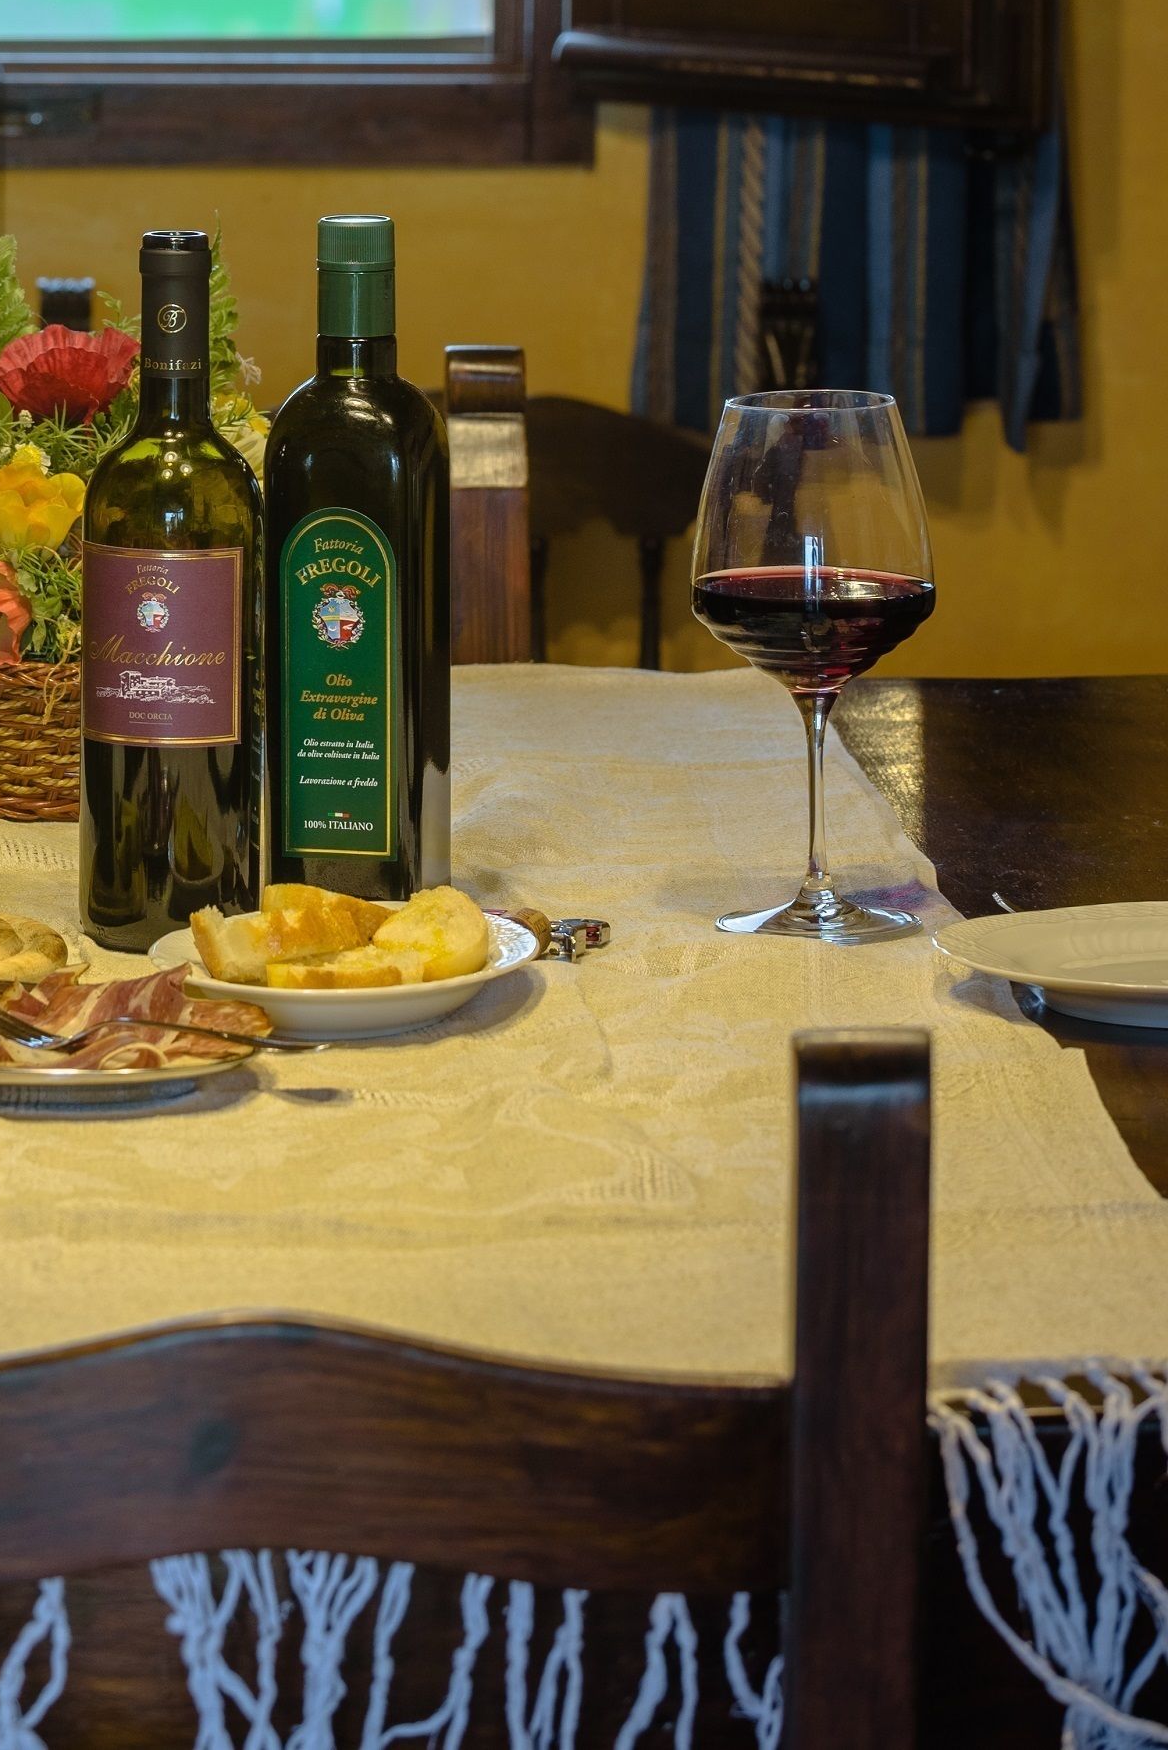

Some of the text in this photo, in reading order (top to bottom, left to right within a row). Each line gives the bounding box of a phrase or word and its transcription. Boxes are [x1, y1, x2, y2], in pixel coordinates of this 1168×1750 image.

[144, 358, 202, 371] Bonifazi
[314, 538, 364, 554] Fattoria
[294, 557, 382, 588] FREGOLI
[125, 575, 180, 595] FREGOLI
[90, 634, 225, 666] Macchione
[326, 674, 352, 687] Olio
[299, 691, 378, 707] Extravergine
[129, 711, 173, 720] DOC ORCIA
[314, 708, 365, 721] di Oliva
[304, 738, 319, 747] Olio
[346, 740, 354, 748] in
[356, 740, 374, 749] Italia
[297, 749, 380, 760] da olive coltivate in Italia
[299, 776, 346, 786] Lavorazione
[352, 777, 378, 788] freddo
[304, 820, 373, 831] 100% ITALIANO
